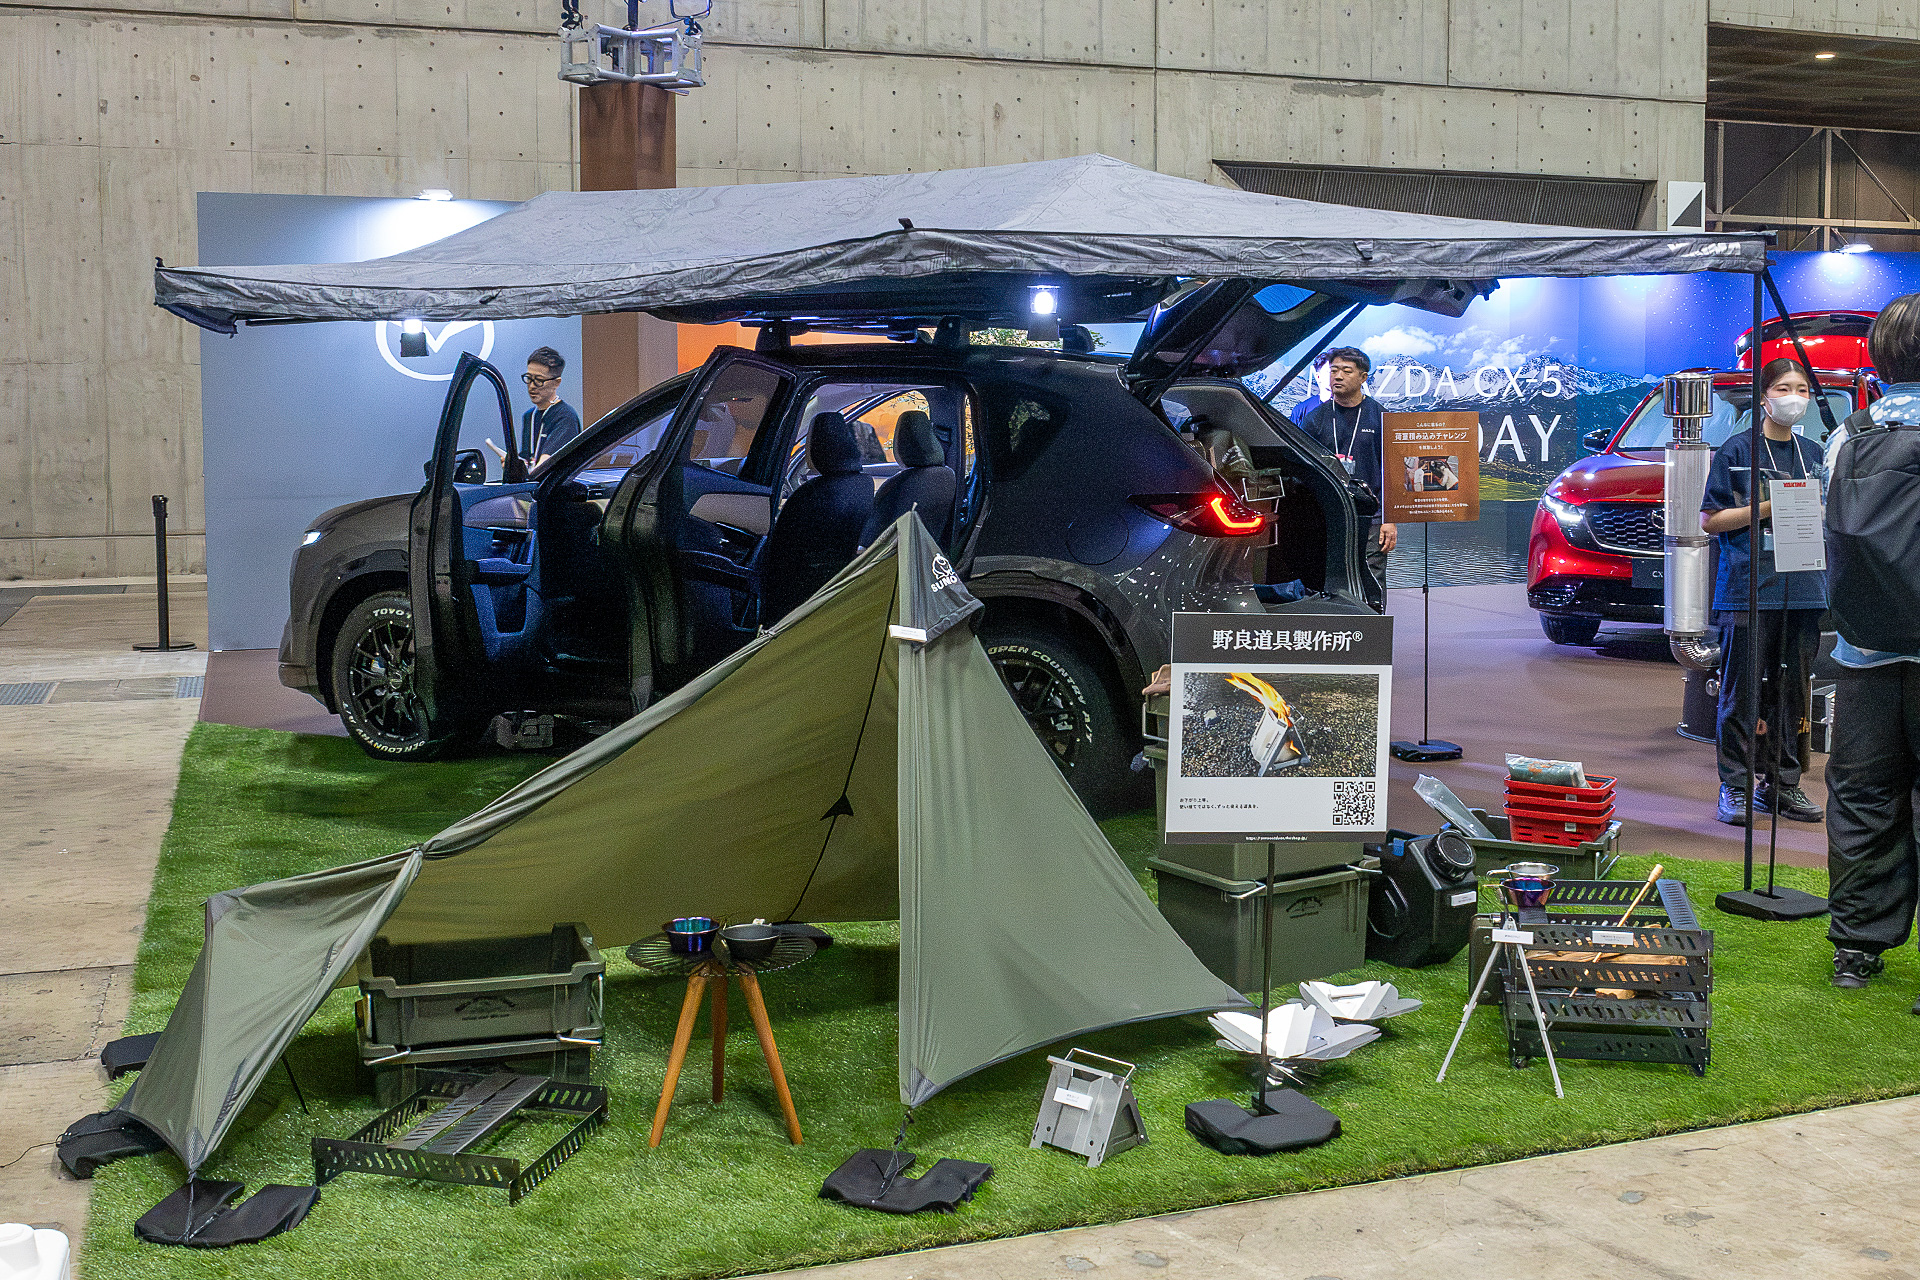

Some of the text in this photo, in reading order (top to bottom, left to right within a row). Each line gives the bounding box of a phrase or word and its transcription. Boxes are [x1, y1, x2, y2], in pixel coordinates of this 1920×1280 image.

[1306, 365, 1562, 398] ZDA CX-5
[1477, 414, 1562, 462] AY
[373, 608, 405, 617] TOYO
[988, 645, 1029, 655] OPEN
[1032, 650, 1086, 705] COUNTRY
